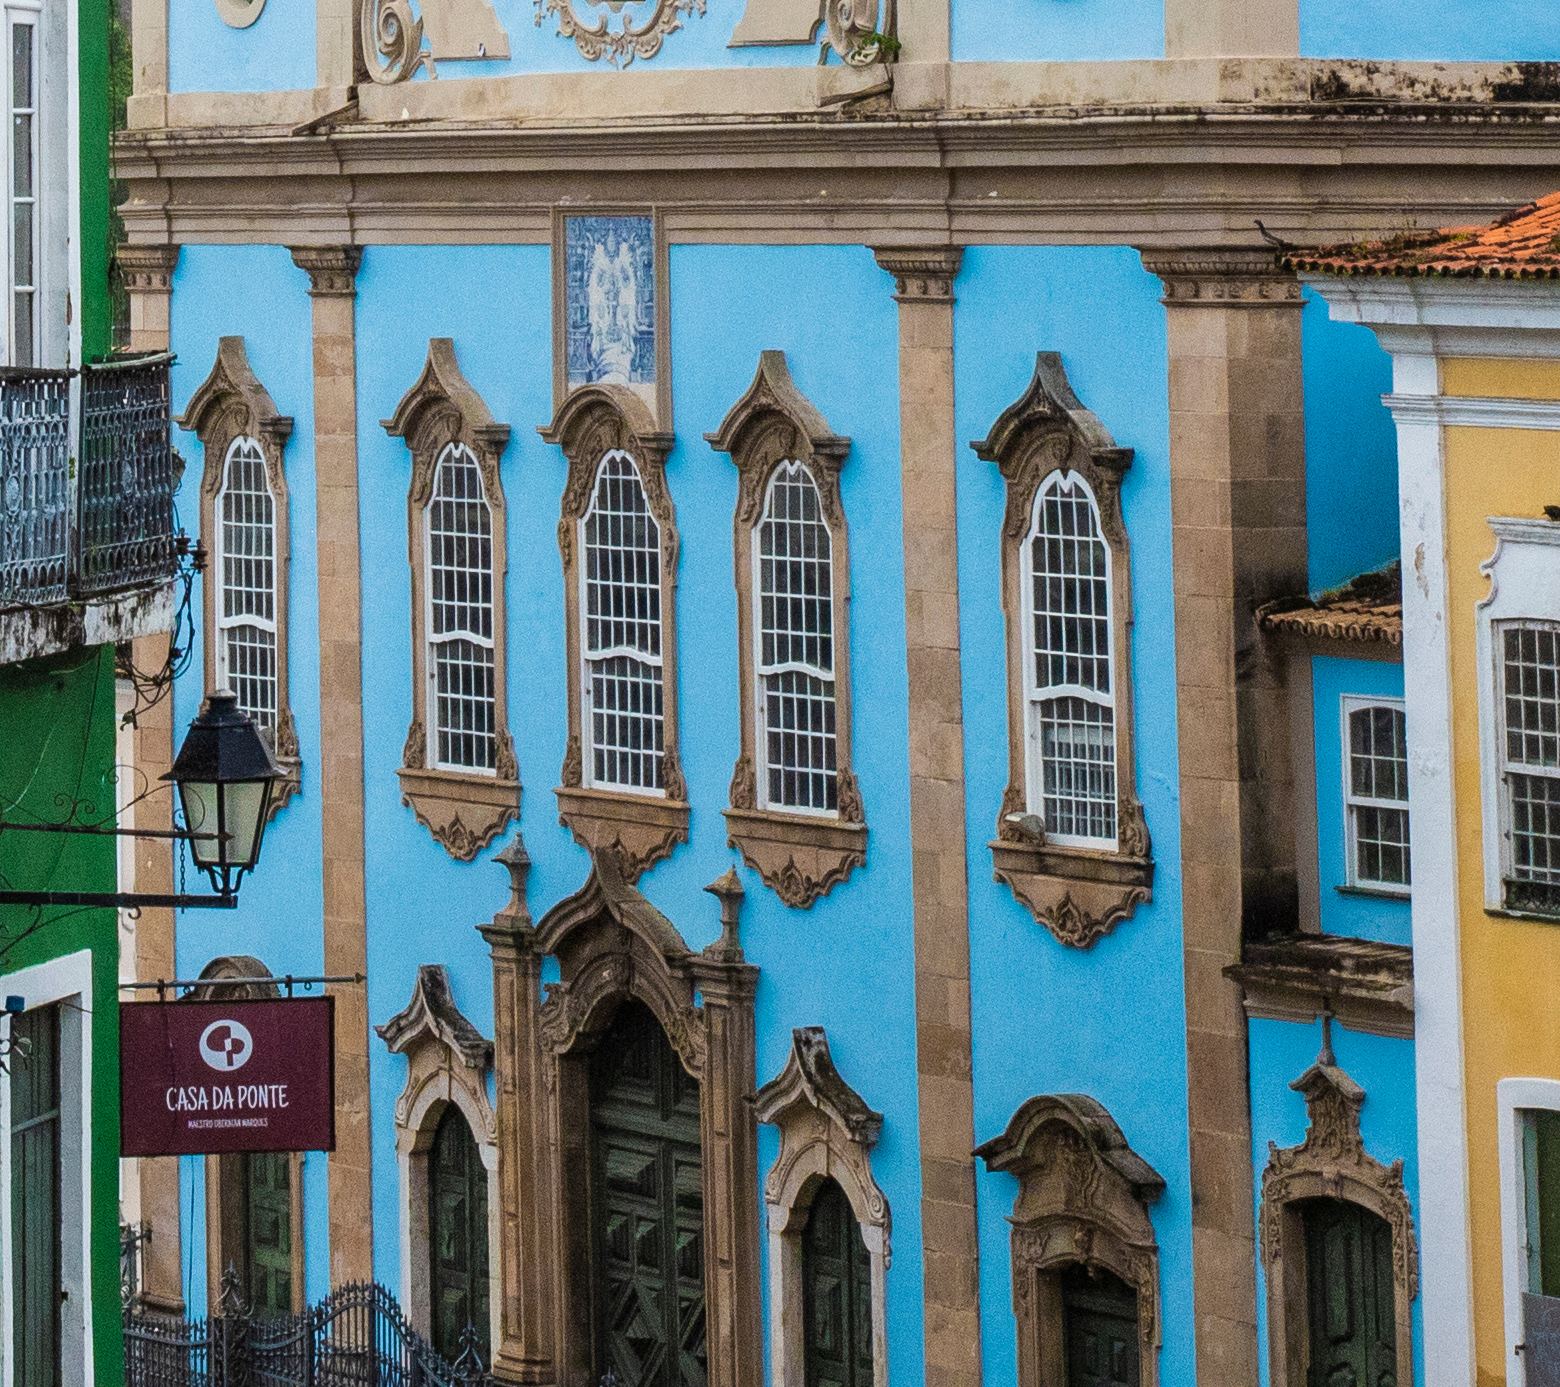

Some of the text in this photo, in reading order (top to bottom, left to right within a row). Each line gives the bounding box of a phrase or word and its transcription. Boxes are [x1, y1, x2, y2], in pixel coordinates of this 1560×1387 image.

[166, 1084, 289, 1111] CASA DA PONTE
